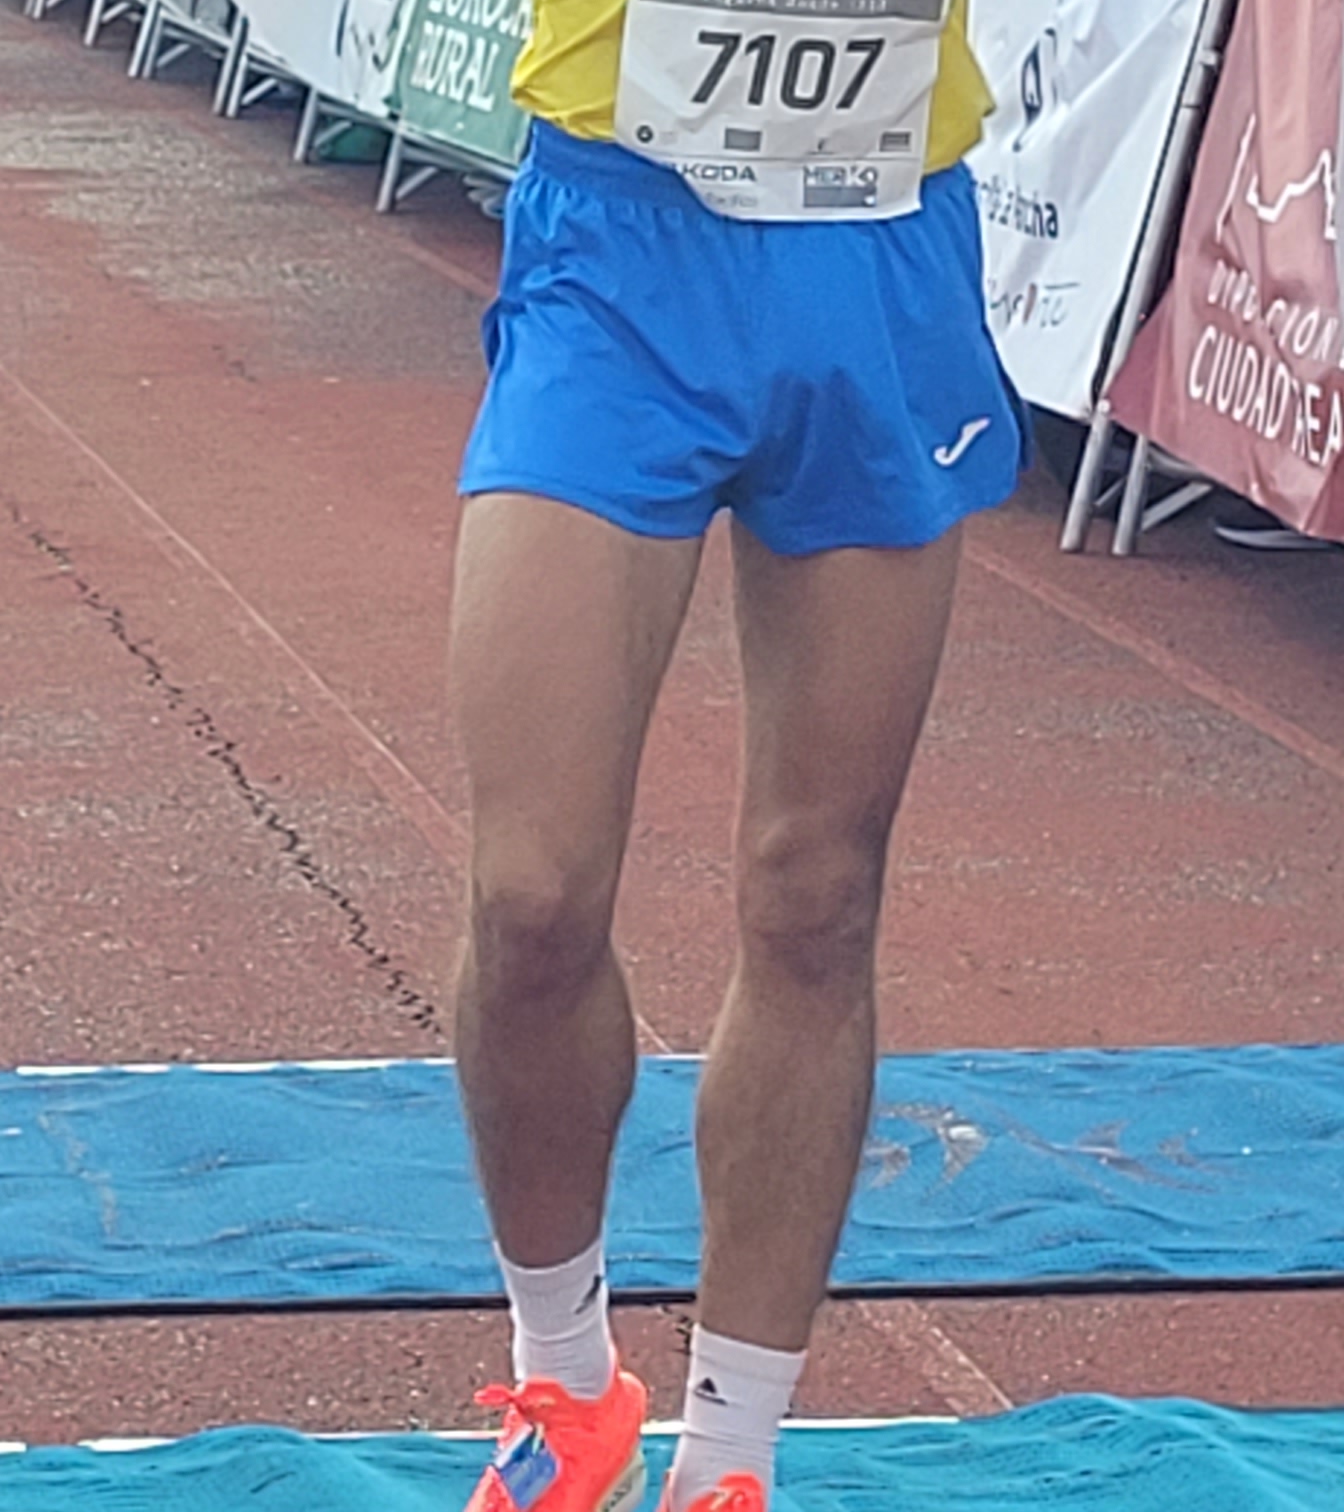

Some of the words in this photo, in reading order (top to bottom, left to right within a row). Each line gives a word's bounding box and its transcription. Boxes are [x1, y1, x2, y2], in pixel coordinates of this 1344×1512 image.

[690, 29, 886, 110] 7107
[674, 163, 757, 183] KODA
[1188, 324, 1290, 440] CIUDAD
